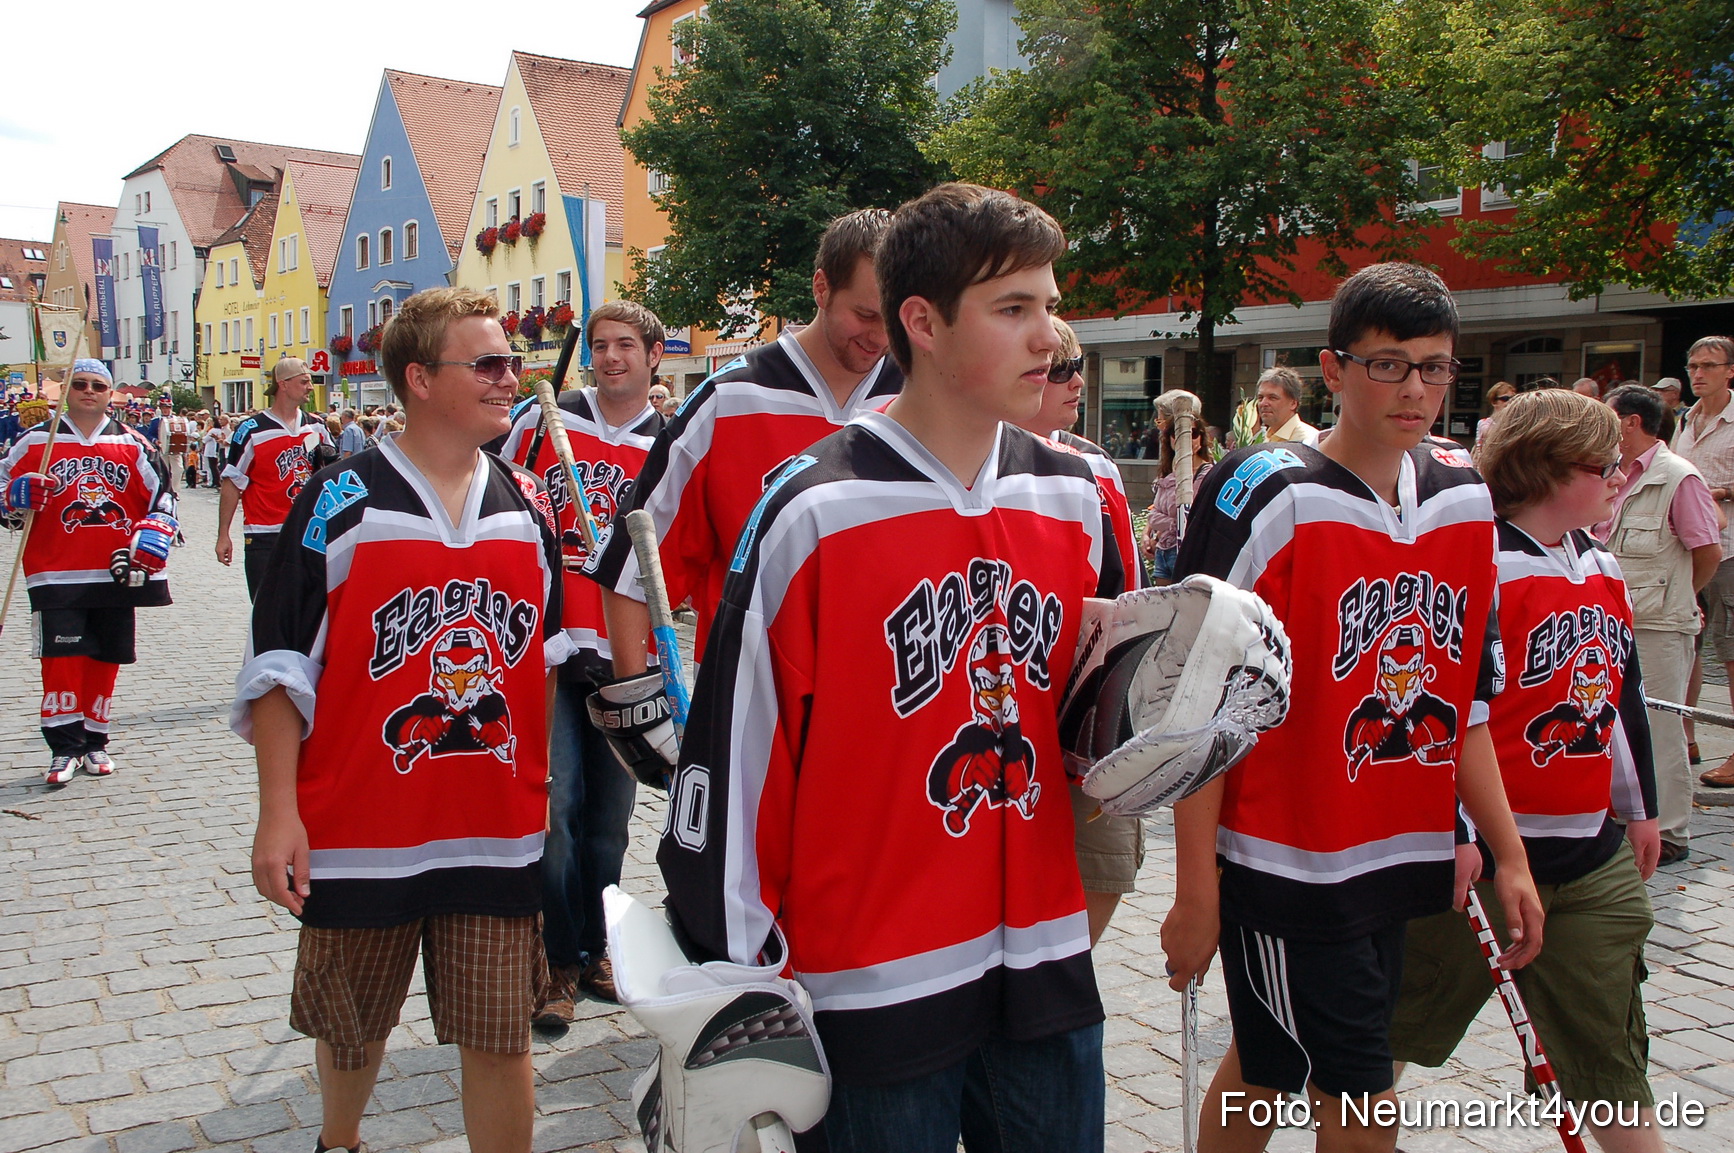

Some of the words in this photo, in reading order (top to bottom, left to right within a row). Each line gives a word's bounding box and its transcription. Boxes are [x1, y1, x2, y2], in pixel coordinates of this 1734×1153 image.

[151, 269, 161, 309] RUPPERT
[664, 344, 688, 352] eisebüro
[50, 456, 130, 497] Eagles
[275, 445, 318, 481] Eagle
[55, 635, 82, 643] Cooper
[368, 577, 538, 681] Eagles
[884, 556, 1063, 719] Eagles
[42, 691, 77, 714] 40
[591, 696, 671, 729] SSION
